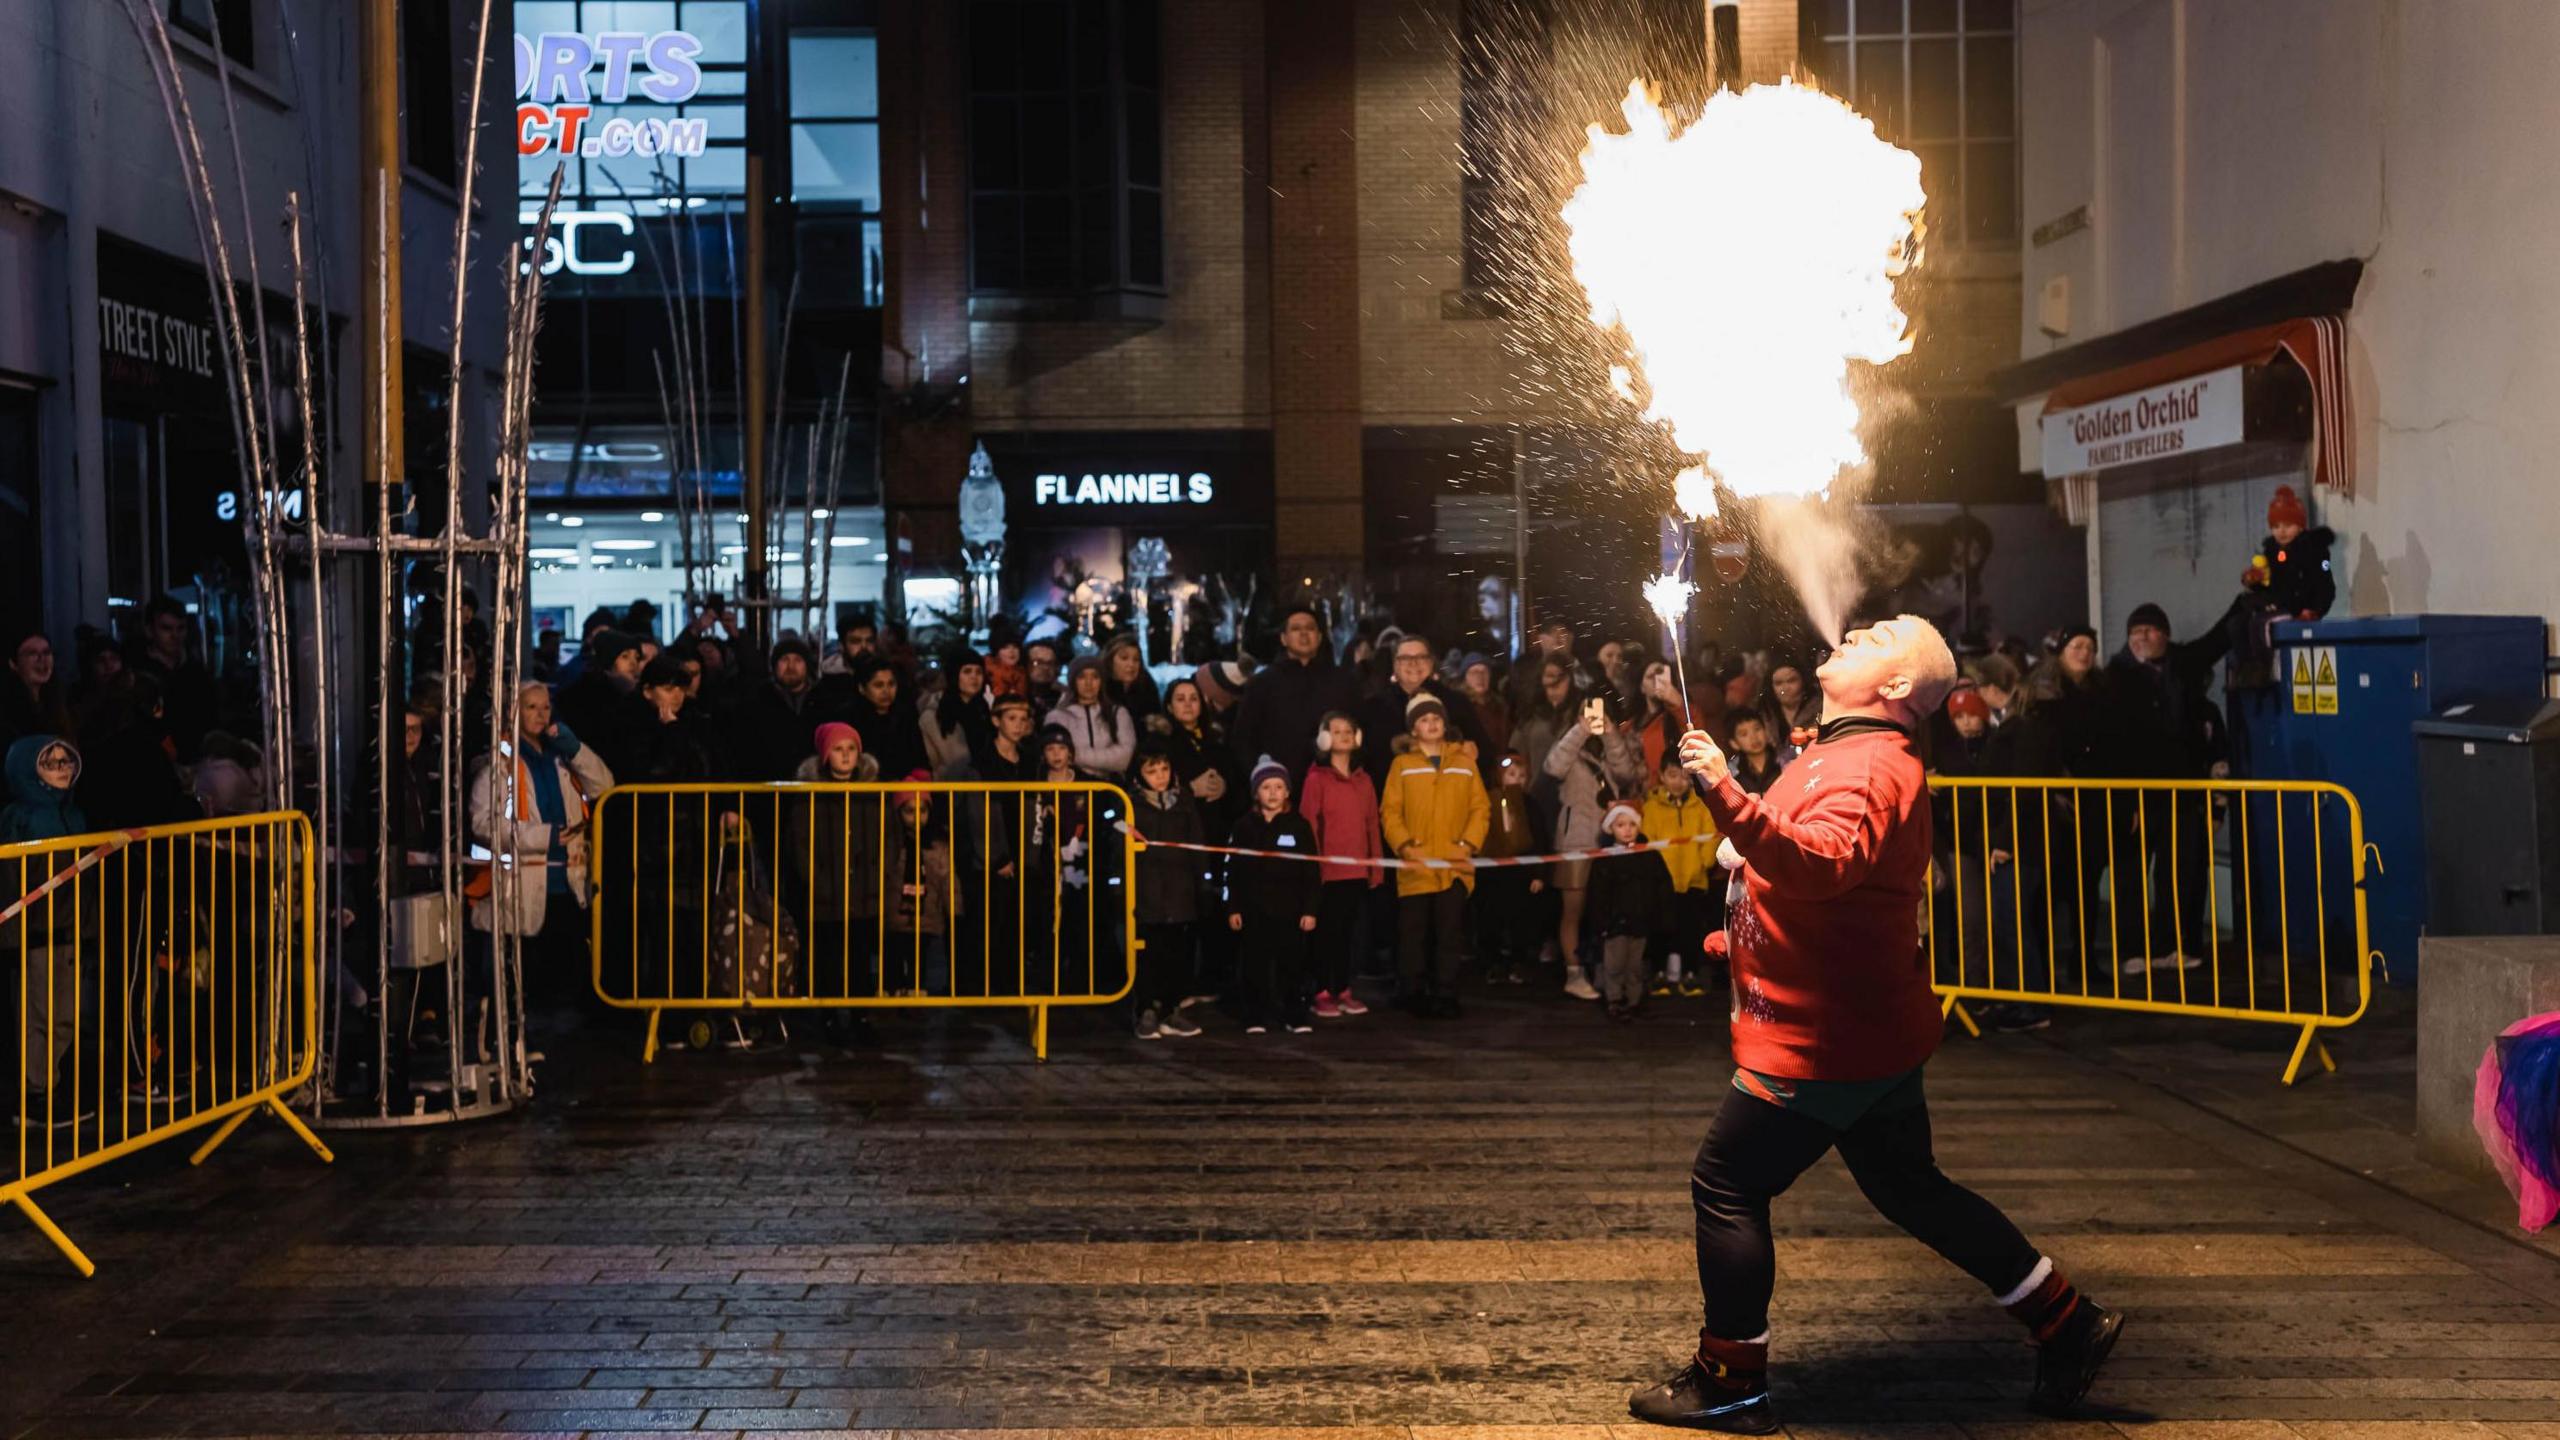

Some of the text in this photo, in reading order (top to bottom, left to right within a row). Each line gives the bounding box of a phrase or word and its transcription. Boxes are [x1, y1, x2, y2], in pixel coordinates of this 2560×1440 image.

[100, 296, 159, 362] TREET
[164, 315, 213, 377] STYLE
[2137, 380, 2208, 430] Orchid"
[2088, 429, 2184, 467] FAMILY JEWELLERS
[1035, 472, 1213, 505] FLANNELS
